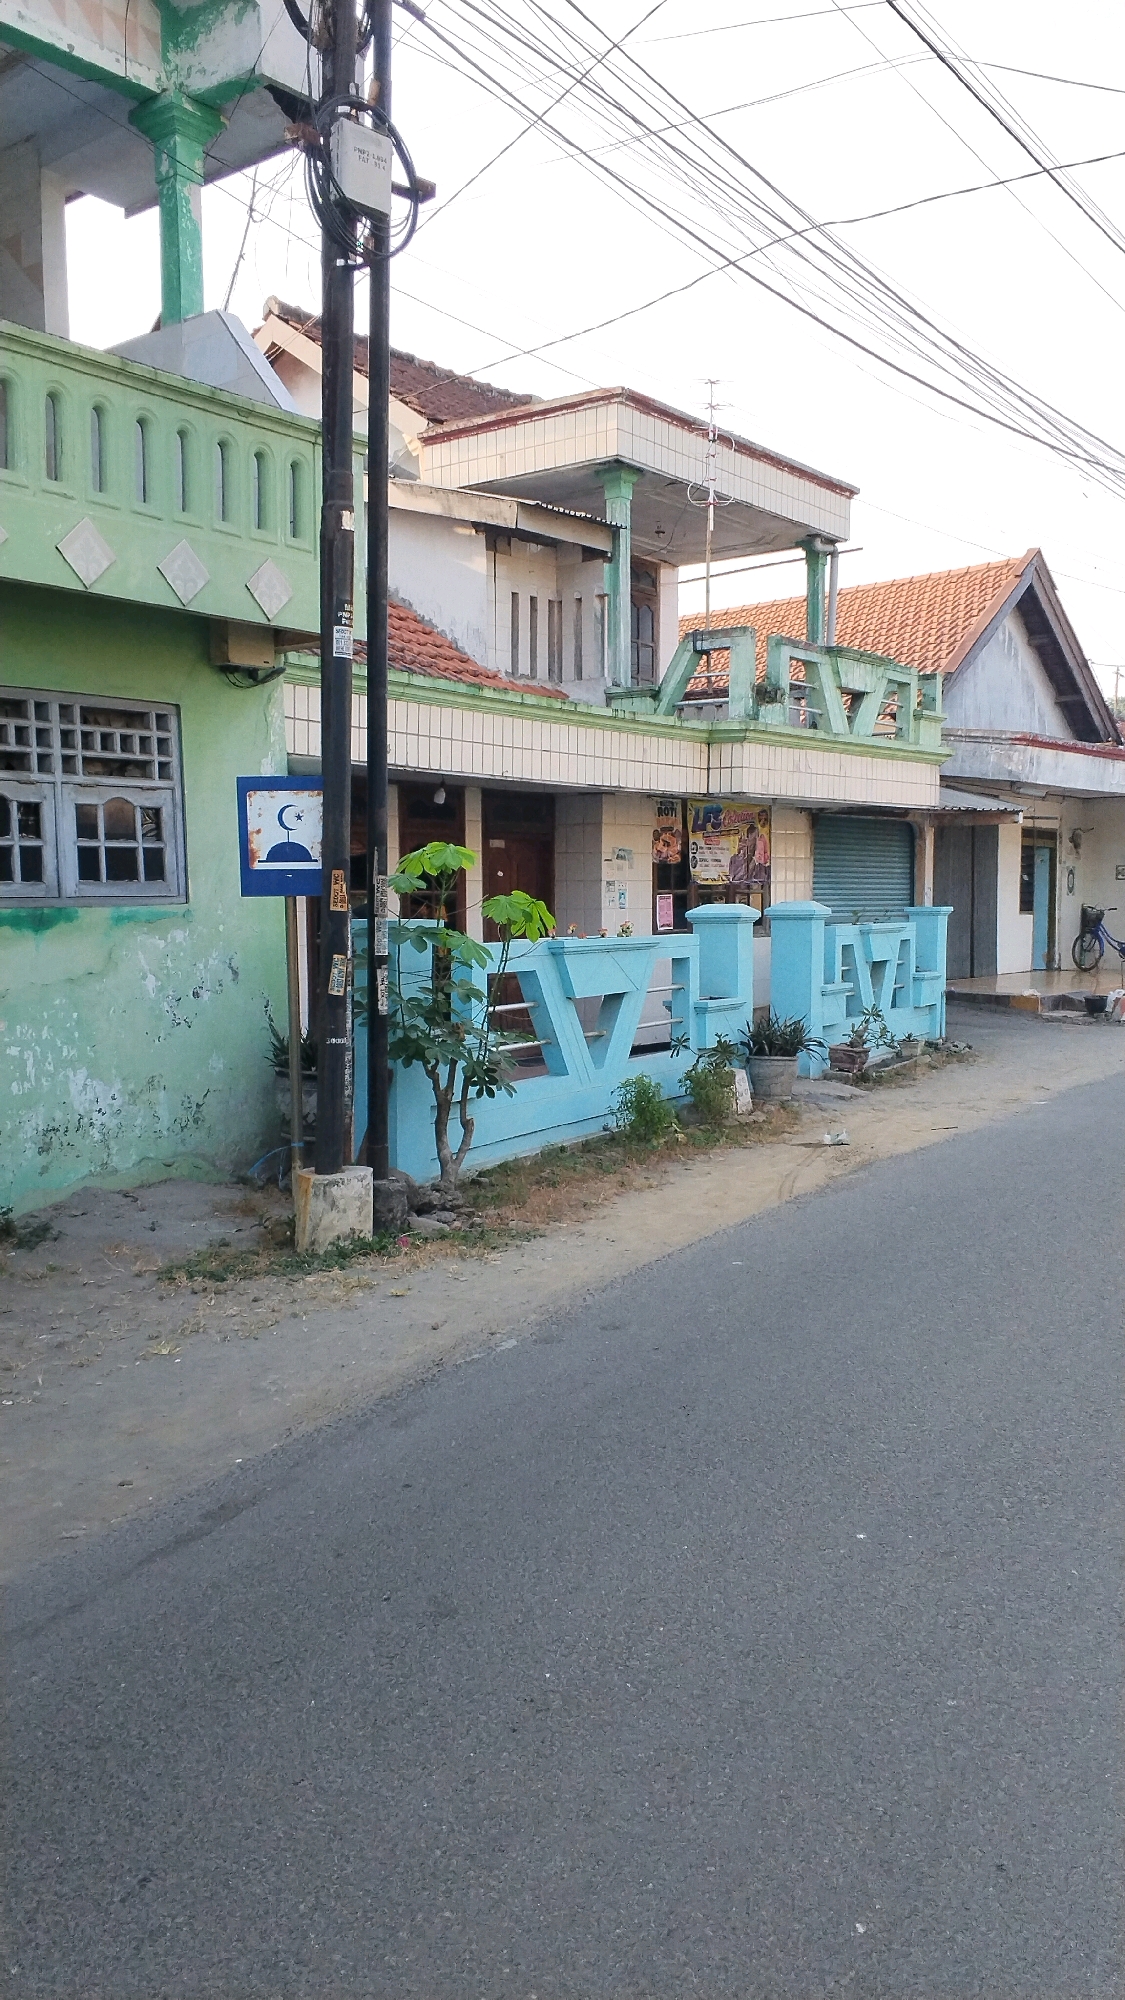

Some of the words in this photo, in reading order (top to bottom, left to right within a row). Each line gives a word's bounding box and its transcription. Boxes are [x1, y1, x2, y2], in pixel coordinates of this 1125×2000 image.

[657, 807, 677, 817] ROTI
[332, 873, 340, 886] WC
[375, 921, 382, 933] WC
